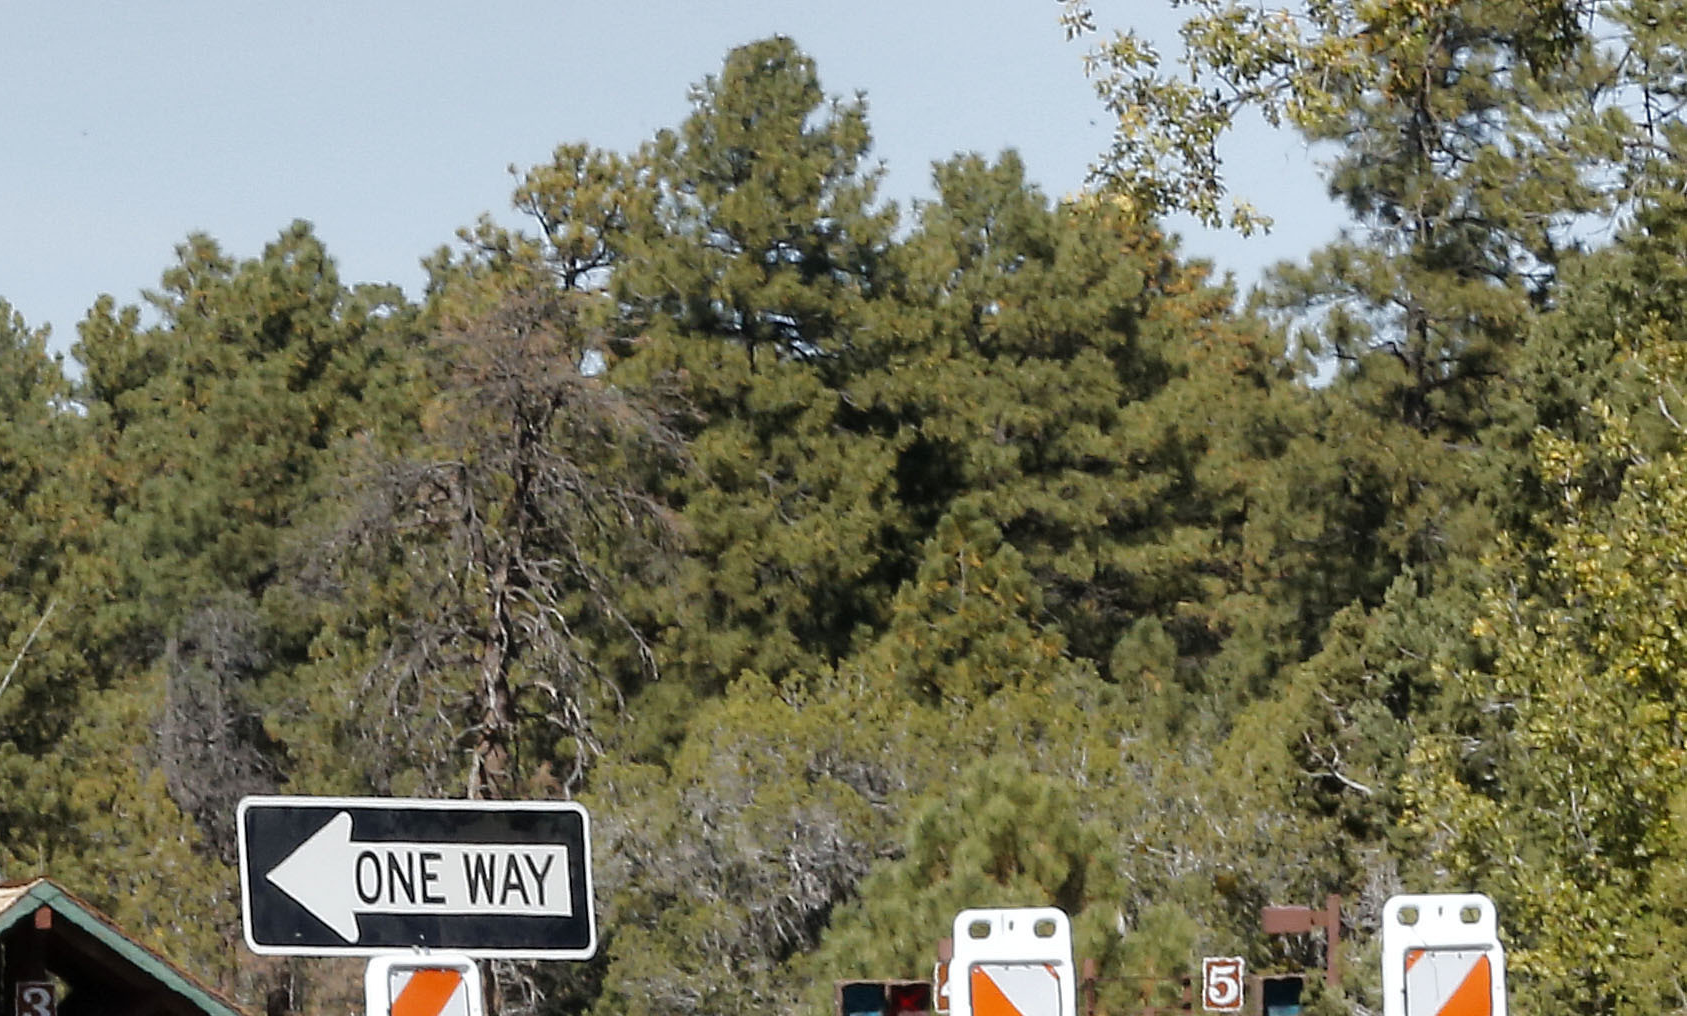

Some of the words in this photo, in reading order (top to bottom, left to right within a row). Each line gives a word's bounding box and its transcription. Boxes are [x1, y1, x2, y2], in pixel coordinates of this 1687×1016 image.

[355, 851, 446, 905] ONE
[464, 853, 554, 906] WAY
[1209, 965, 1239, 1005] 5
